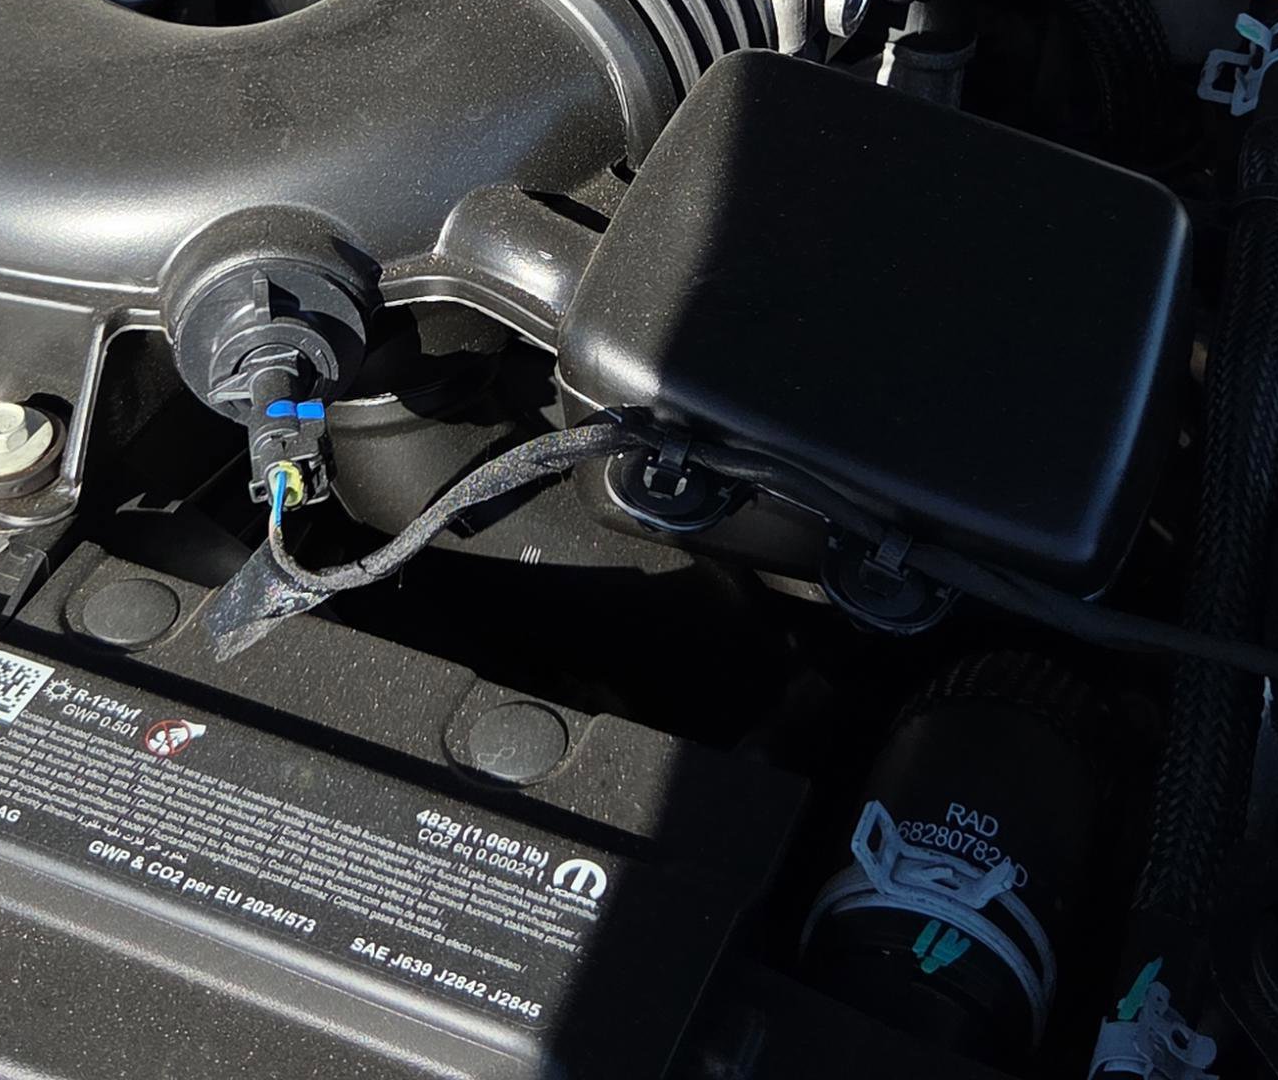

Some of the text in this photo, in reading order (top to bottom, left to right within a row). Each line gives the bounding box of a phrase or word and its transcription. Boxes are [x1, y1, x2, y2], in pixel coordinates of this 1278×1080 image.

[61, 703, 138, 737] GWP 0.501
[73, 688, 141, 720] R-1234yf
[416, 810, 548, 868] 482g (1.060 lb)
[946, 801, 1000, 837] RAD
[418, 828, 452, 848] CO2
[453, 842, 473, 859] eq
[475, 848, 534, 878] 0.00024
[898, 821, 1028, 887] 68280782D
[88, 840, 315, 932] GWP & CO2 per EU 2024/573
[545, 884, 596, 908] MOPAR
[350, 937, 541, 1016] SAE J639 J2842 J2845
